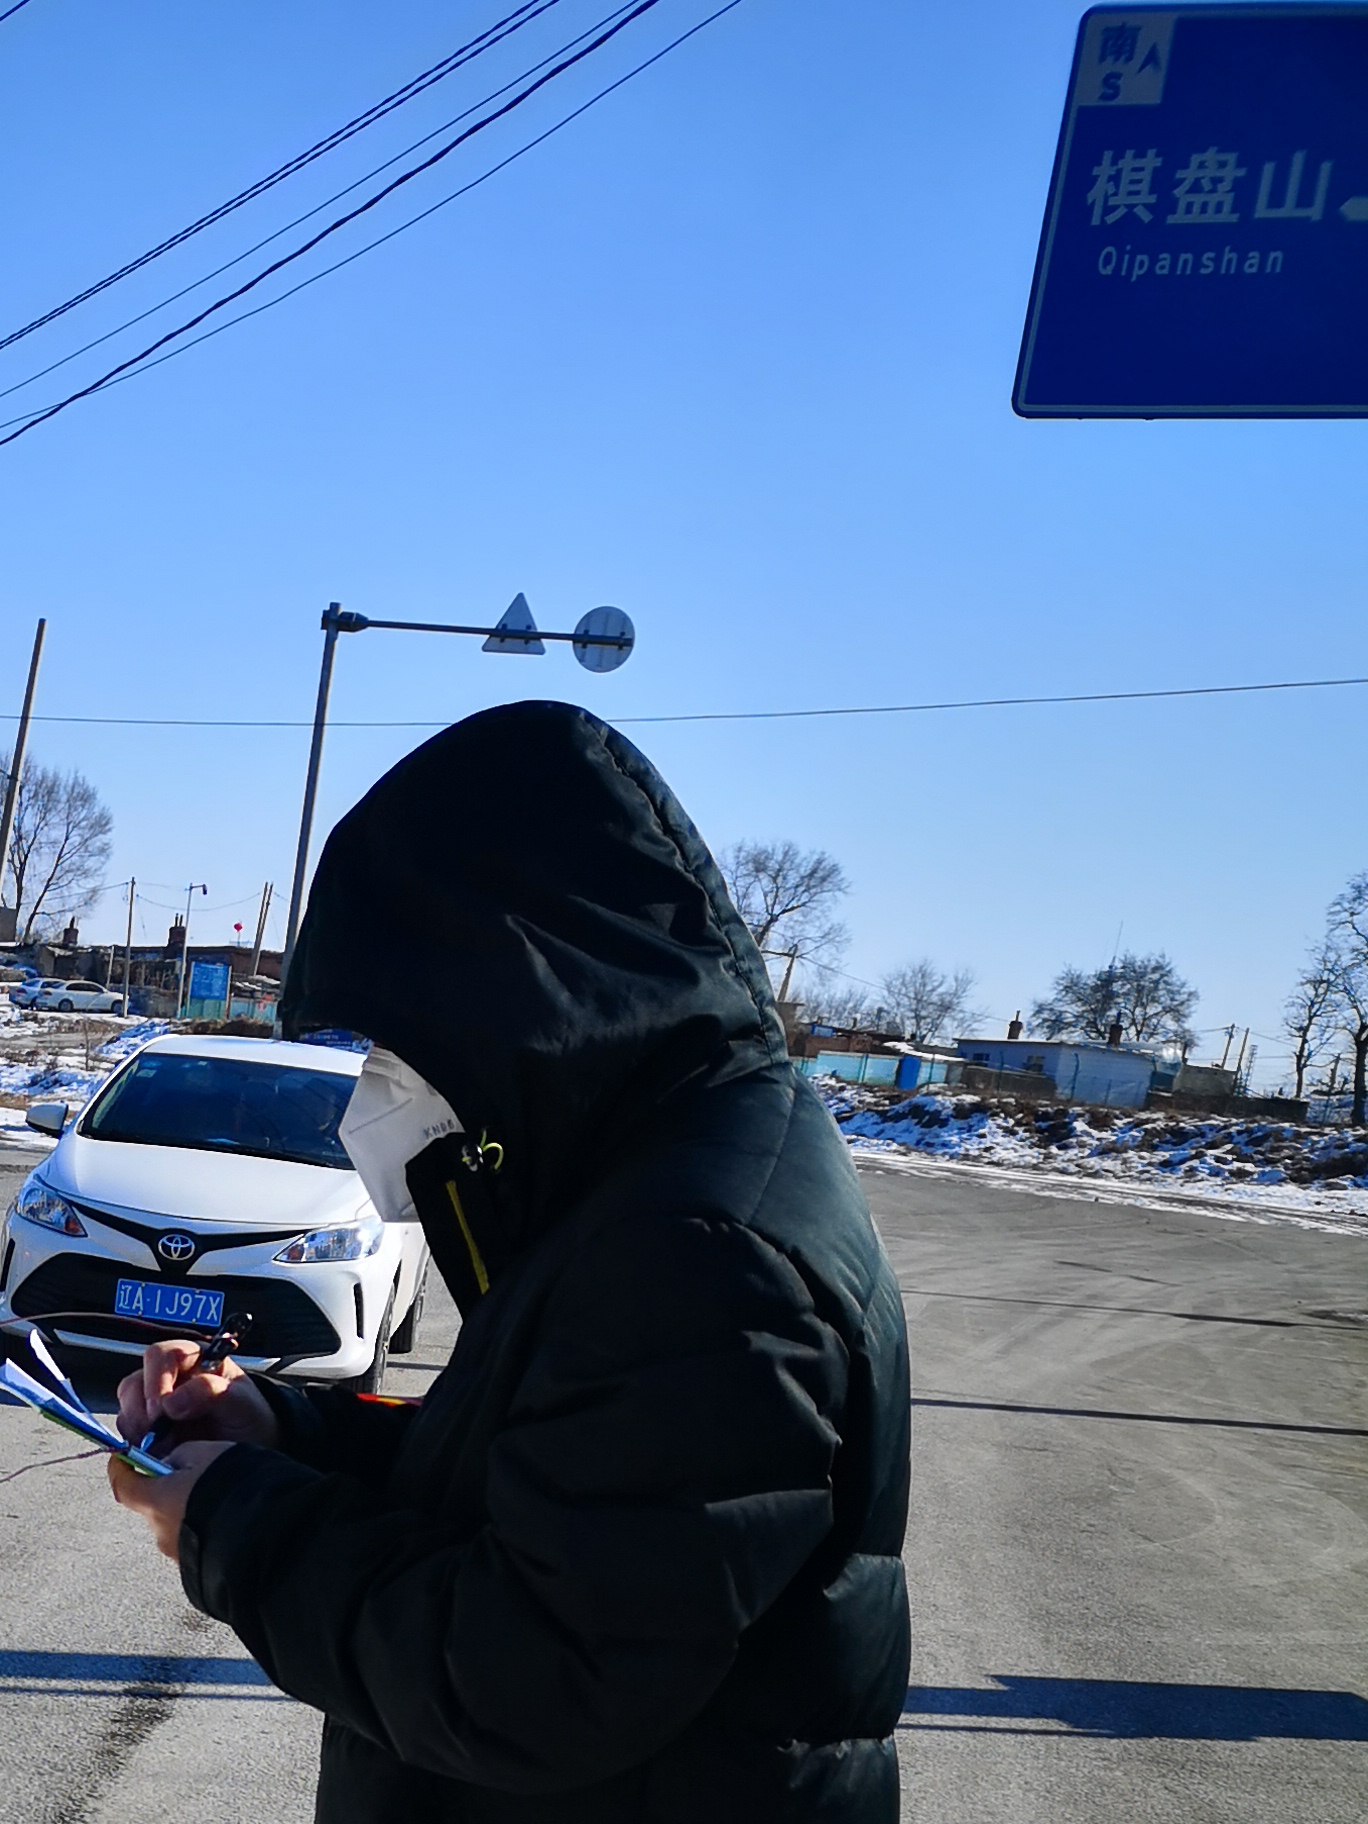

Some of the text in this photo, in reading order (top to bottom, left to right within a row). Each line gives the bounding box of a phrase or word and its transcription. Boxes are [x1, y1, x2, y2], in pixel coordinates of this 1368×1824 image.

[1098, 21, 1142, 65] 南
[1098, 70, 1124, 102] S
[1086, 146, 1332, 226] 棋盘山
[1097, 244, 1285, 282] Qipanshan
